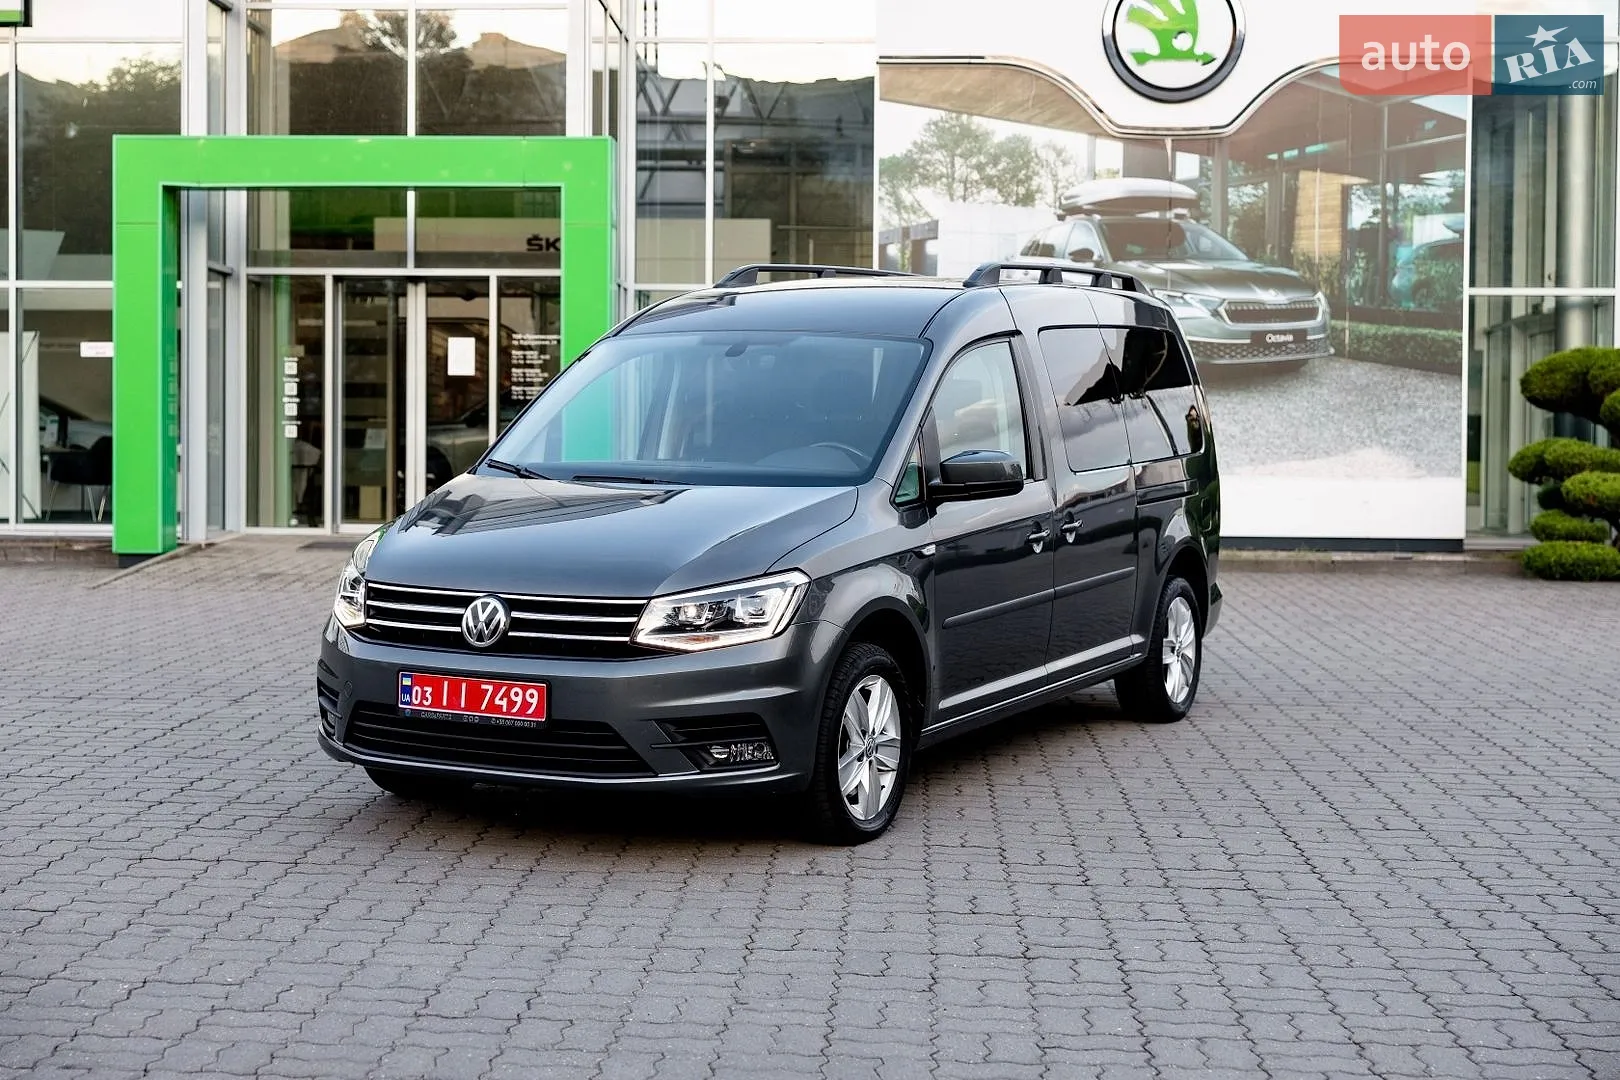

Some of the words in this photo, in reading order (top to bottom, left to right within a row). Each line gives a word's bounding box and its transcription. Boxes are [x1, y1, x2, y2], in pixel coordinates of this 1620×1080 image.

[401, 693, 411, 703] UA
[412, 685, 433, 706] 03
[479, 684, 539, 715] 7499
